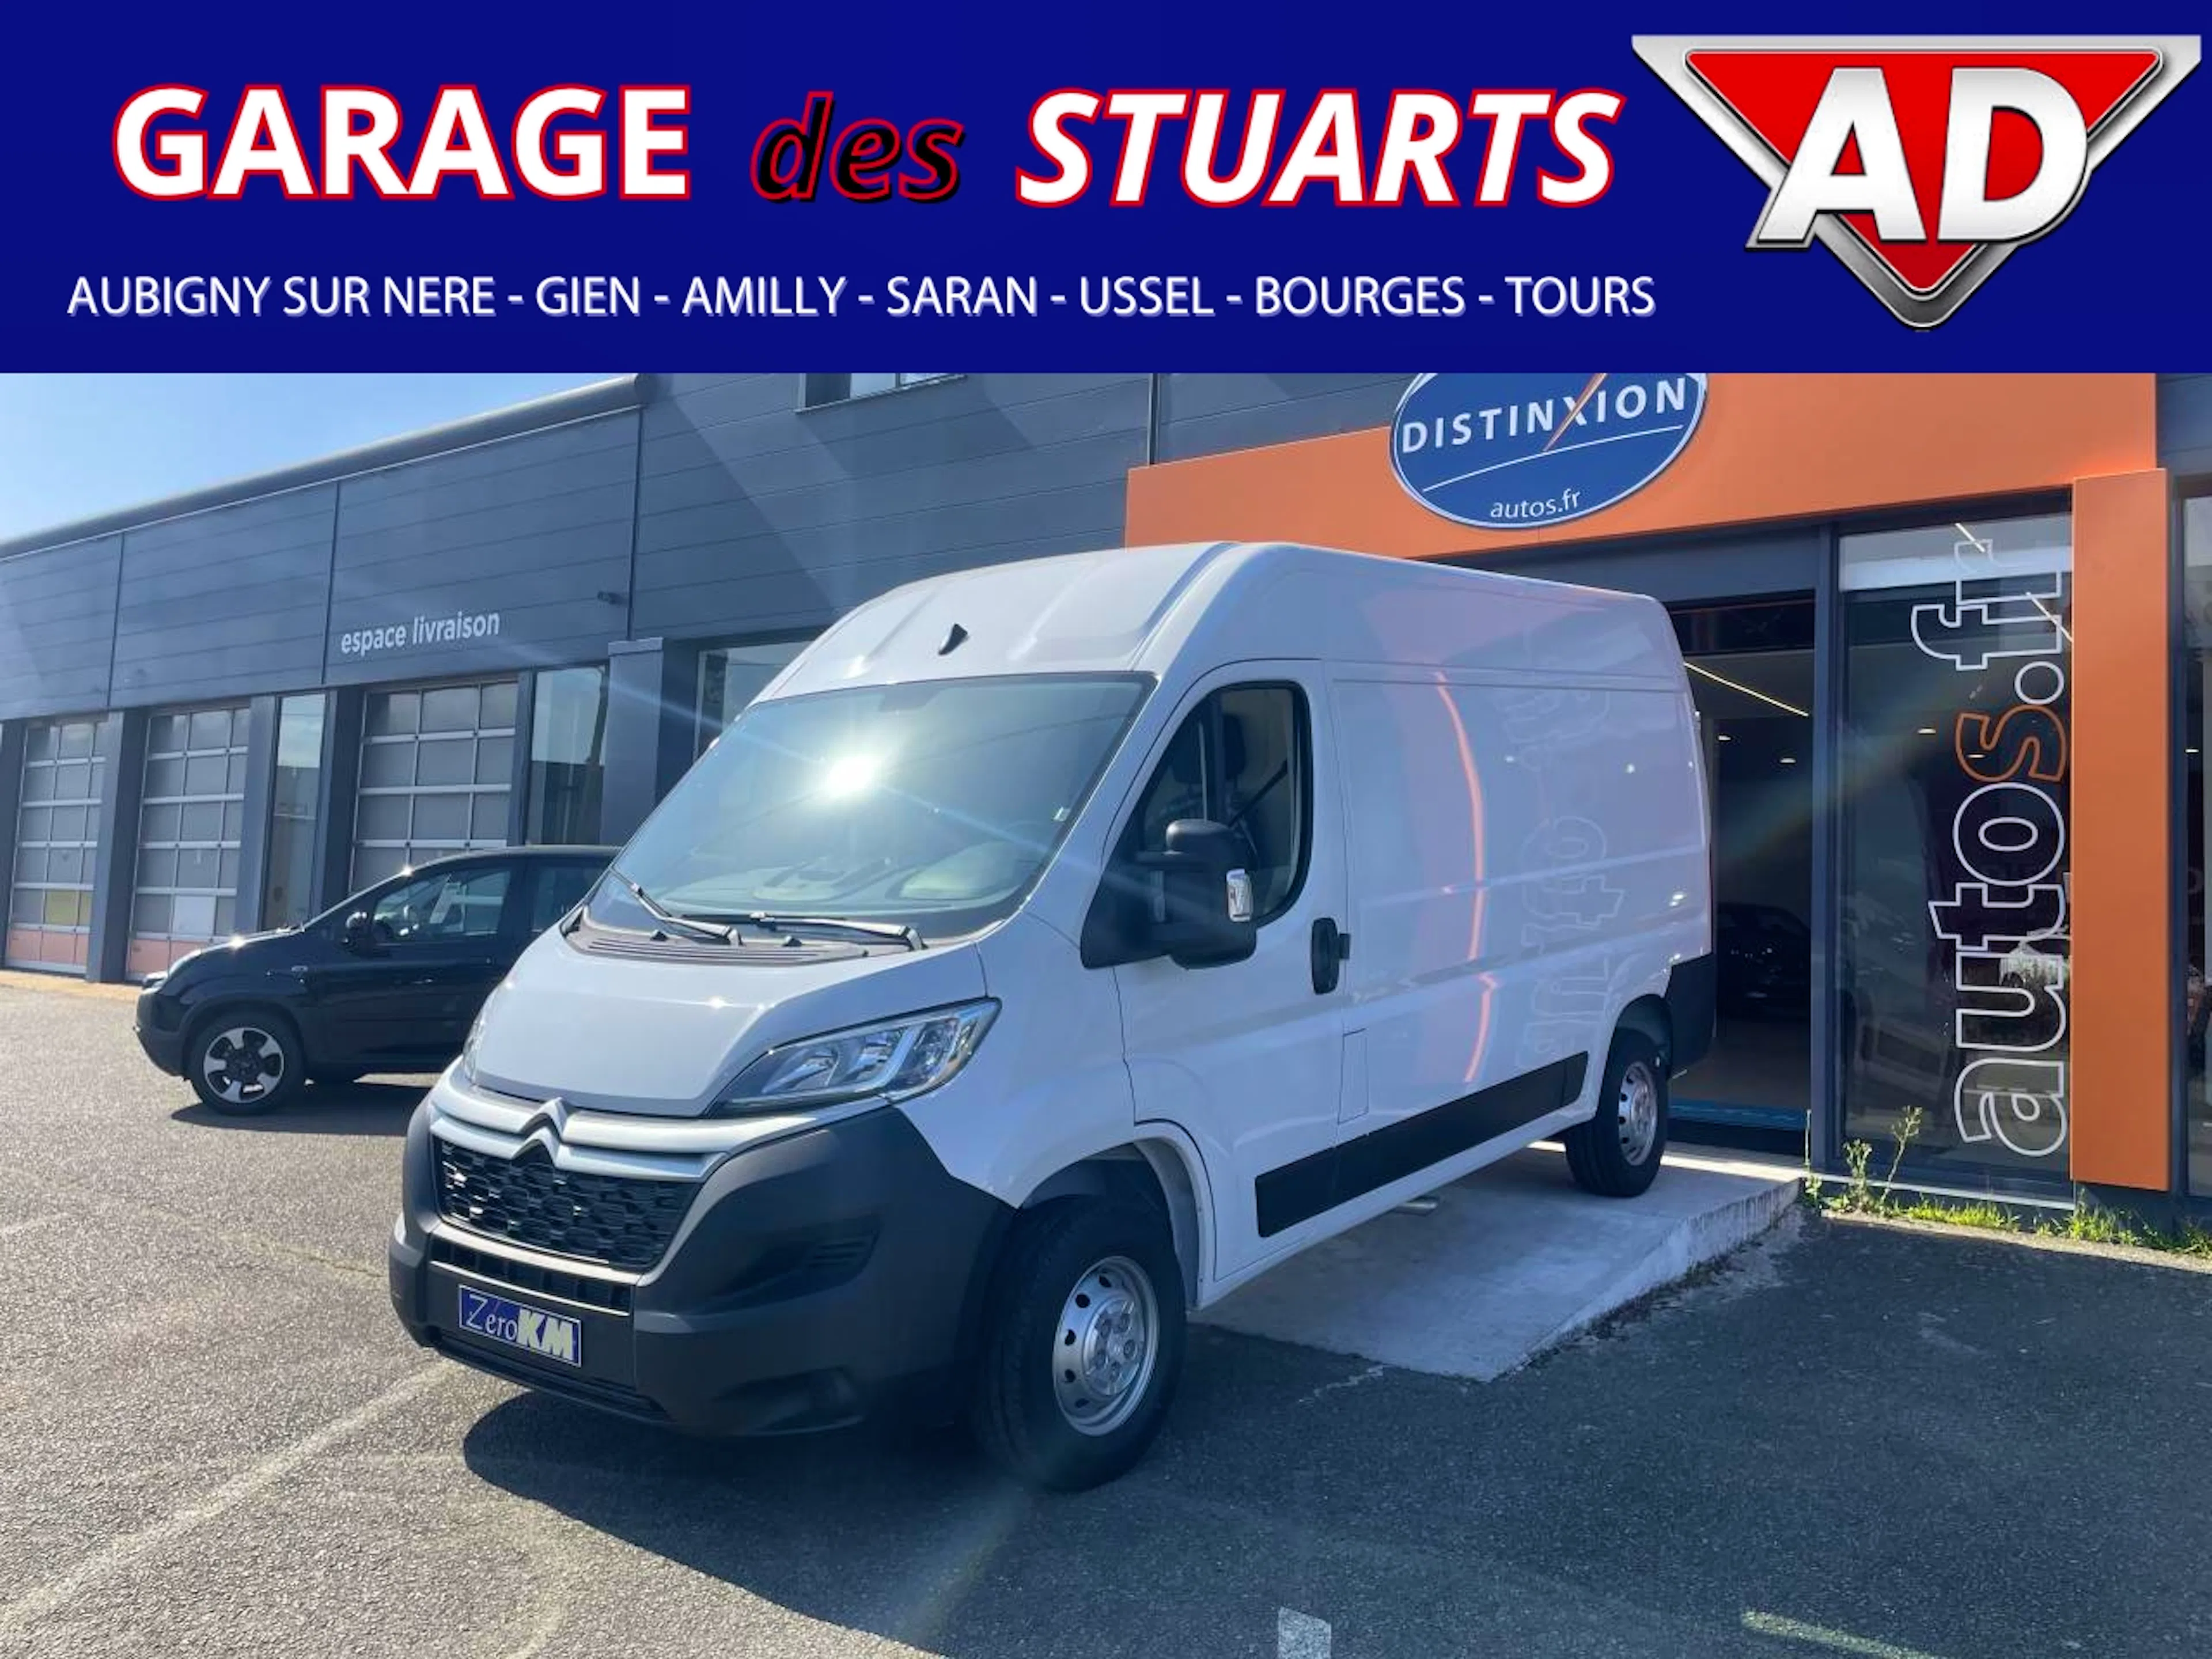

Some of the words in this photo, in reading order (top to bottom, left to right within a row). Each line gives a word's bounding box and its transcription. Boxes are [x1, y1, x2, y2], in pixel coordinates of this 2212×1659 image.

[1402, 377, 1685, 454] DISTINXION
[1490, 488, 1581, 518] autos.fr
[341, 626, 406, 656] espace
[412, 611, 500, 645] livraison
[1911, 538, 2070, 1157] autos.fr
